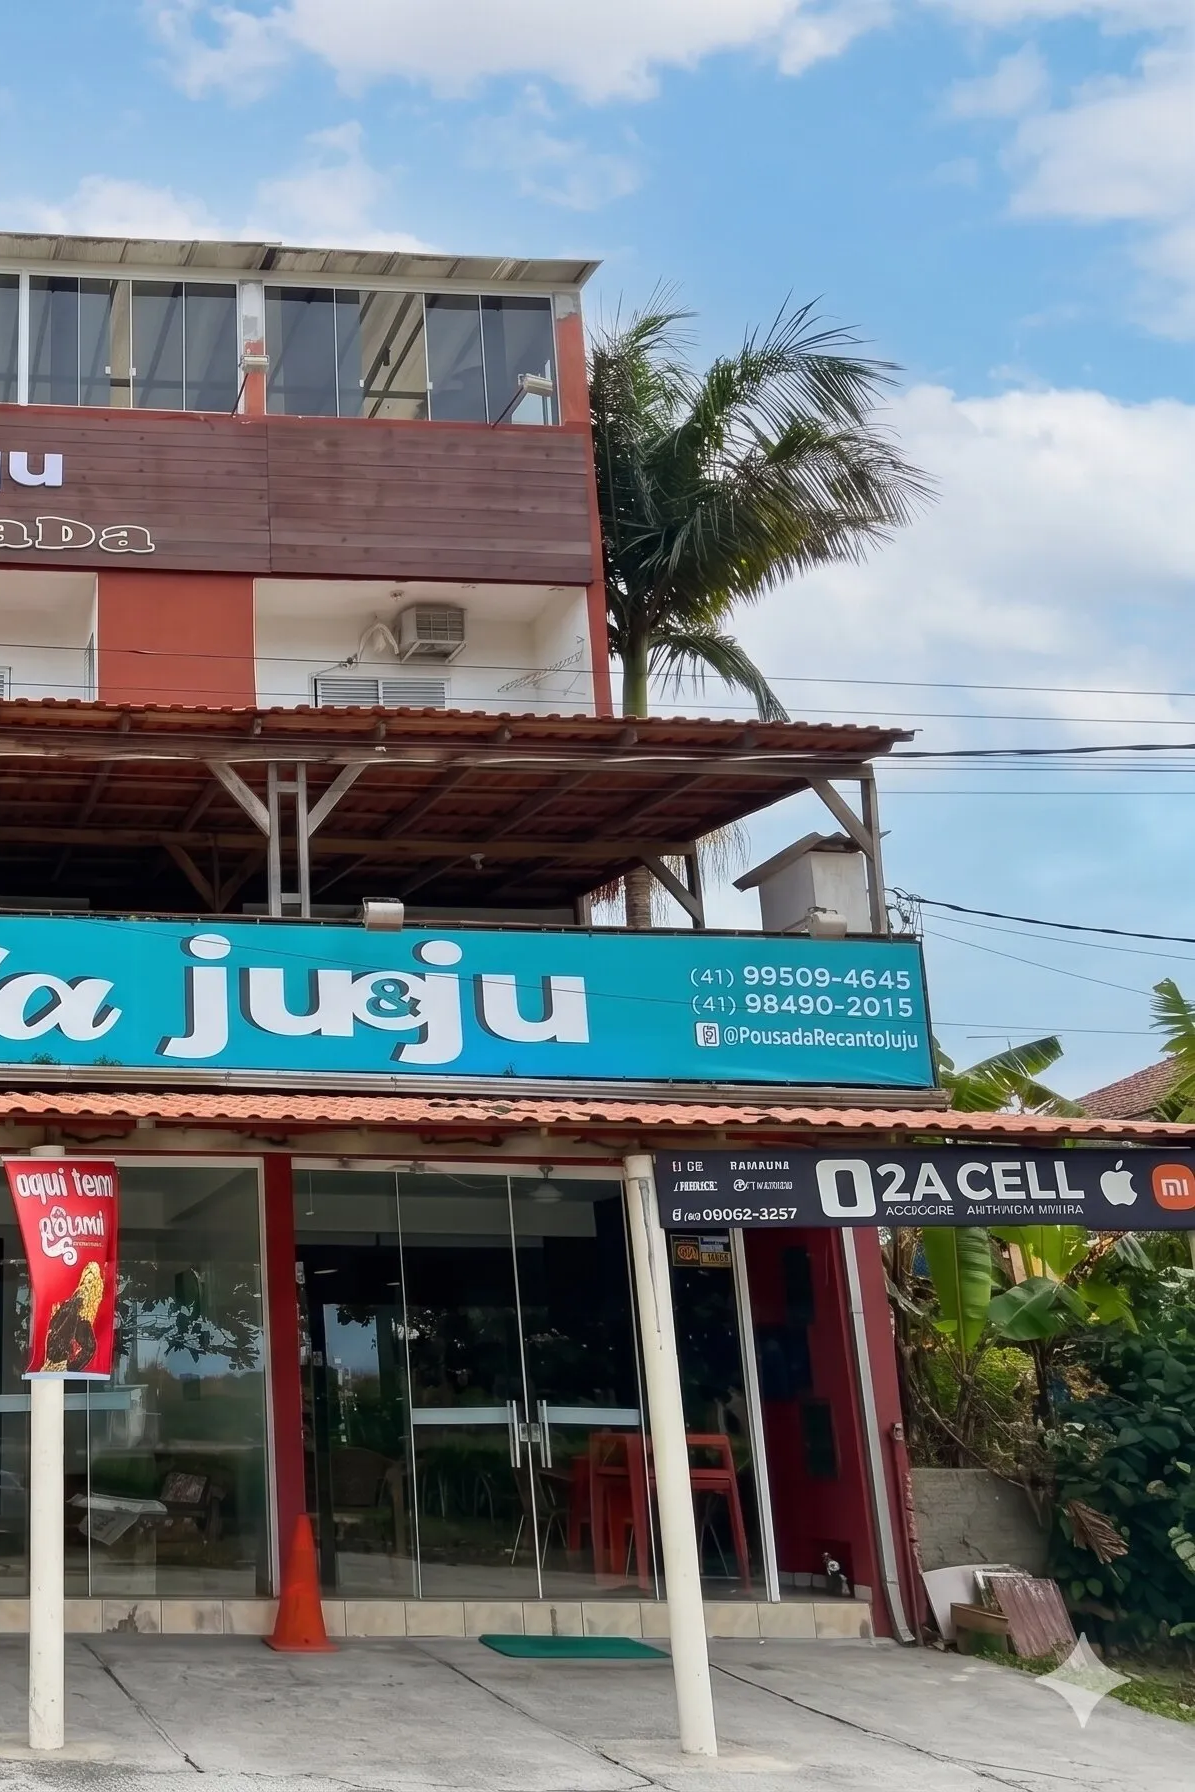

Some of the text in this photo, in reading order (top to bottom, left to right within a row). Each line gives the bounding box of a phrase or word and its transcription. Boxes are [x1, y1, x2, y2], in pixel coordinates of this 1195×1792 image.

[689, 965, 912, 991] (41) 99509-4645
[691, 993, 914, 1018] (41) 98490-2015
[956, 1160, 1086, 1201] CELL
